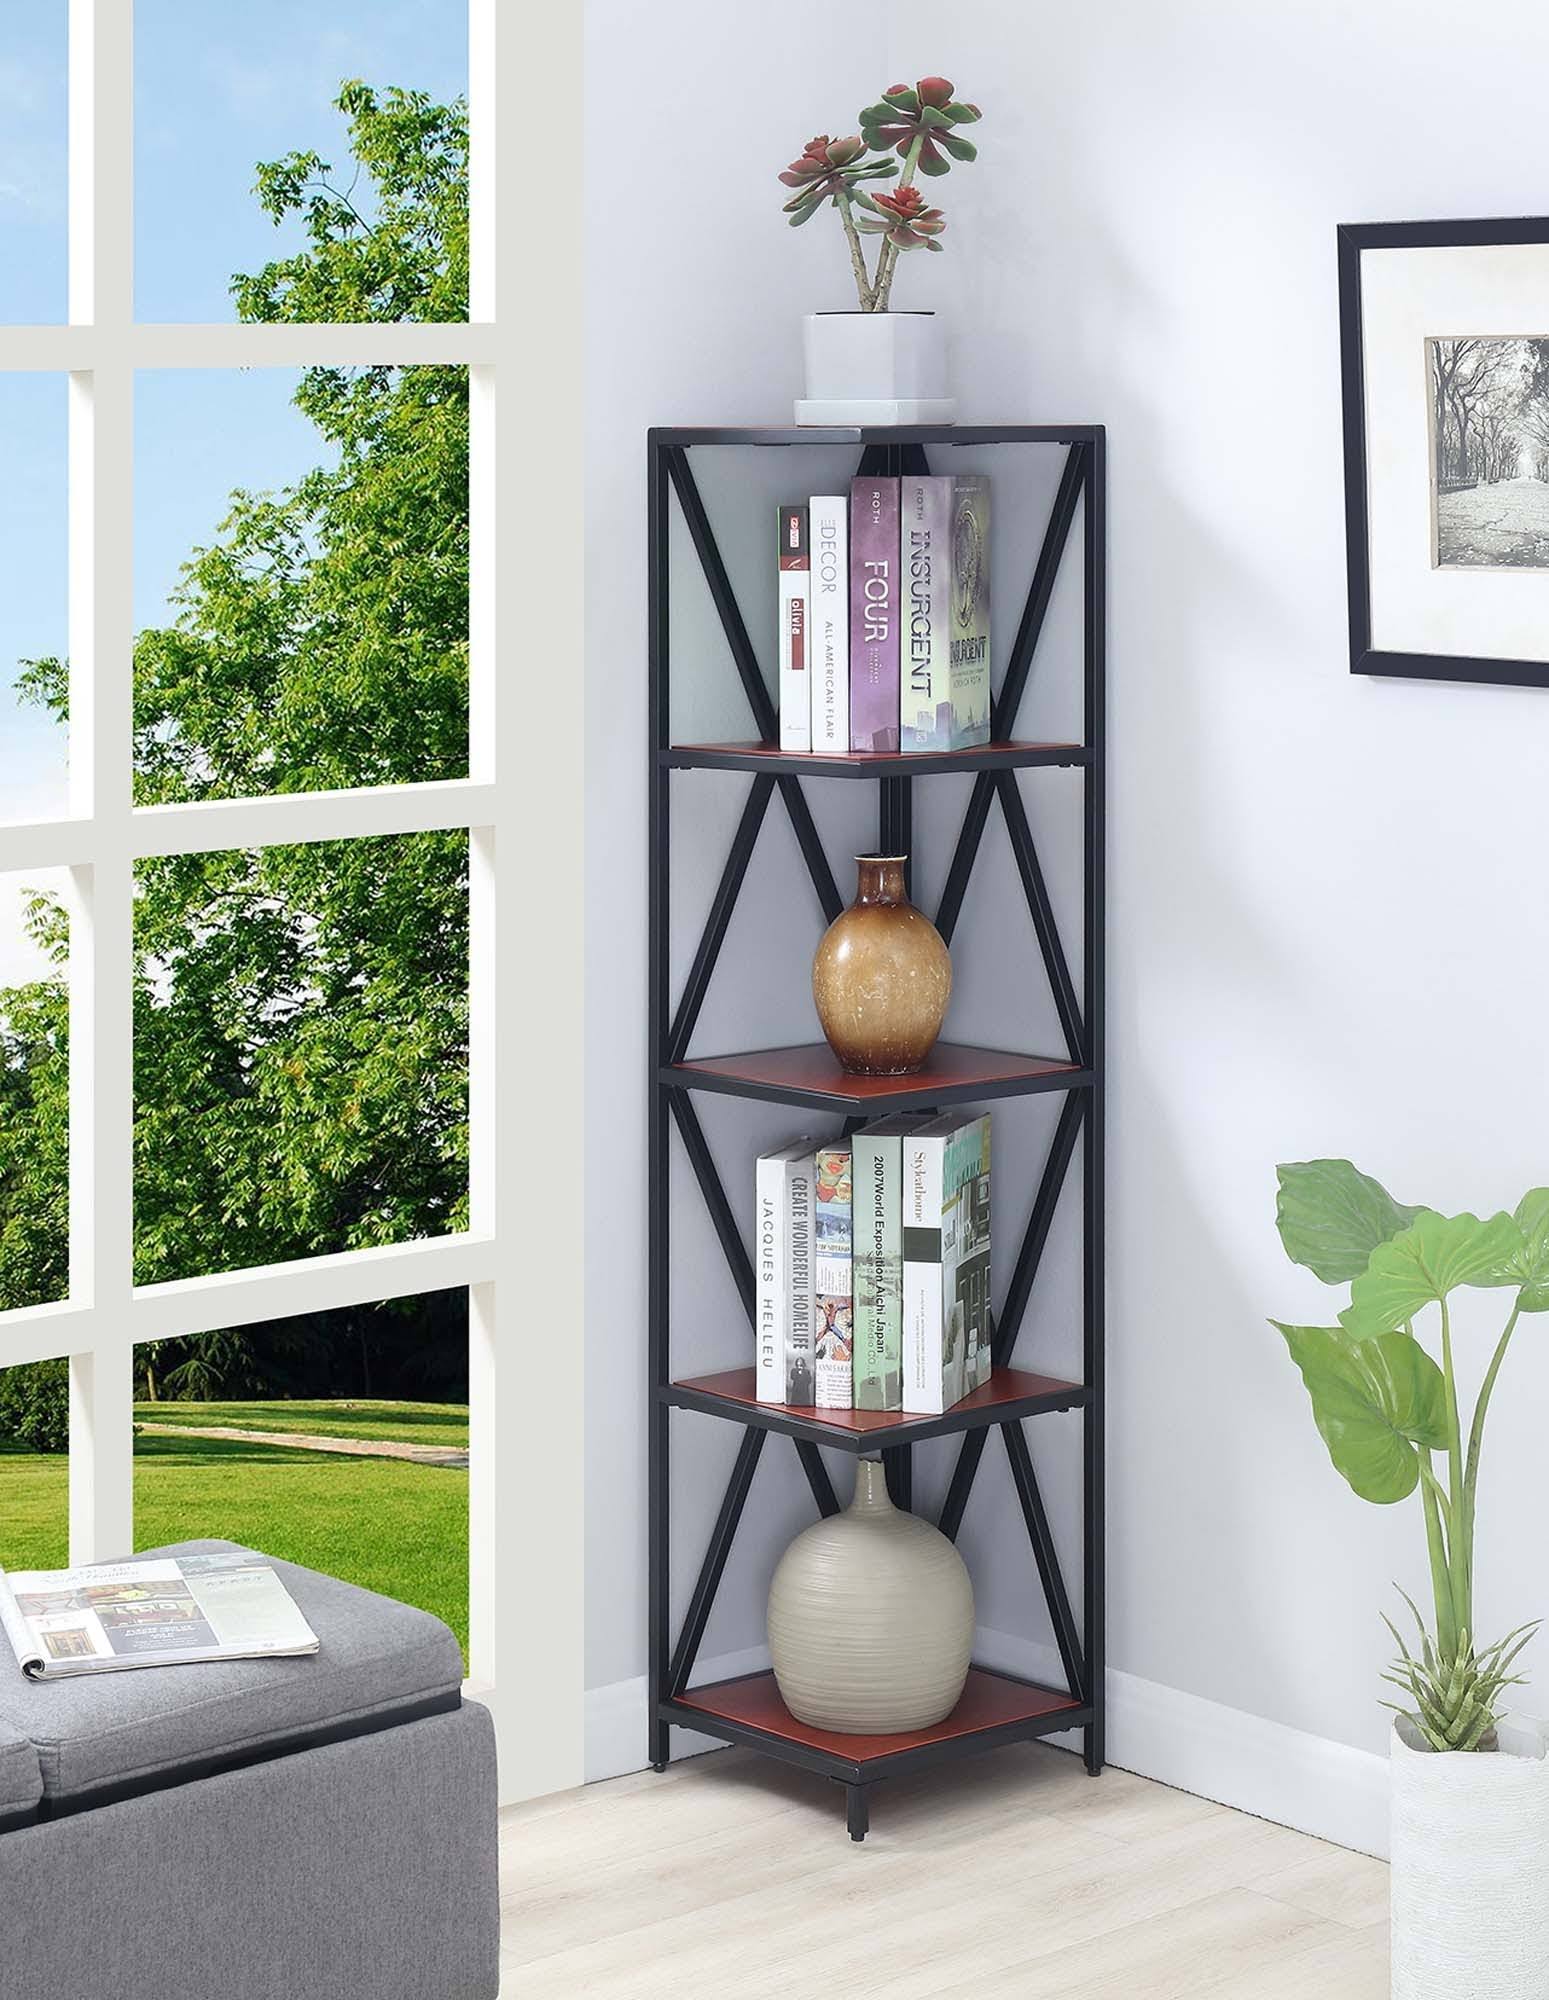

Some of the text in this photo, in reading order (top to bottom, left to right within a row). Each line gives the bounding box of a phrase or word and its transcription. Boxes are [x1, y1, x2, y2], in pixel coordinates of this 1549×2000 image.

[872, 491, 881, 524] ROTH
[791, 600, 803, 635] olivia
[864, 560, 889, 642] FOUR
[911, 531, 931, 697] INSURGENT
[825, 621, 834, 739] ALL-AMERICAN FLAIR
[791, 1177, 808, 1217] CREATE
[762, 1198, 774, 1368] JACQUES HELLEU
[792, 1221, 808, 1290] WONDERFUL
[873, 1156, 885, 1353] 2007World Exposition Aichi Japan
